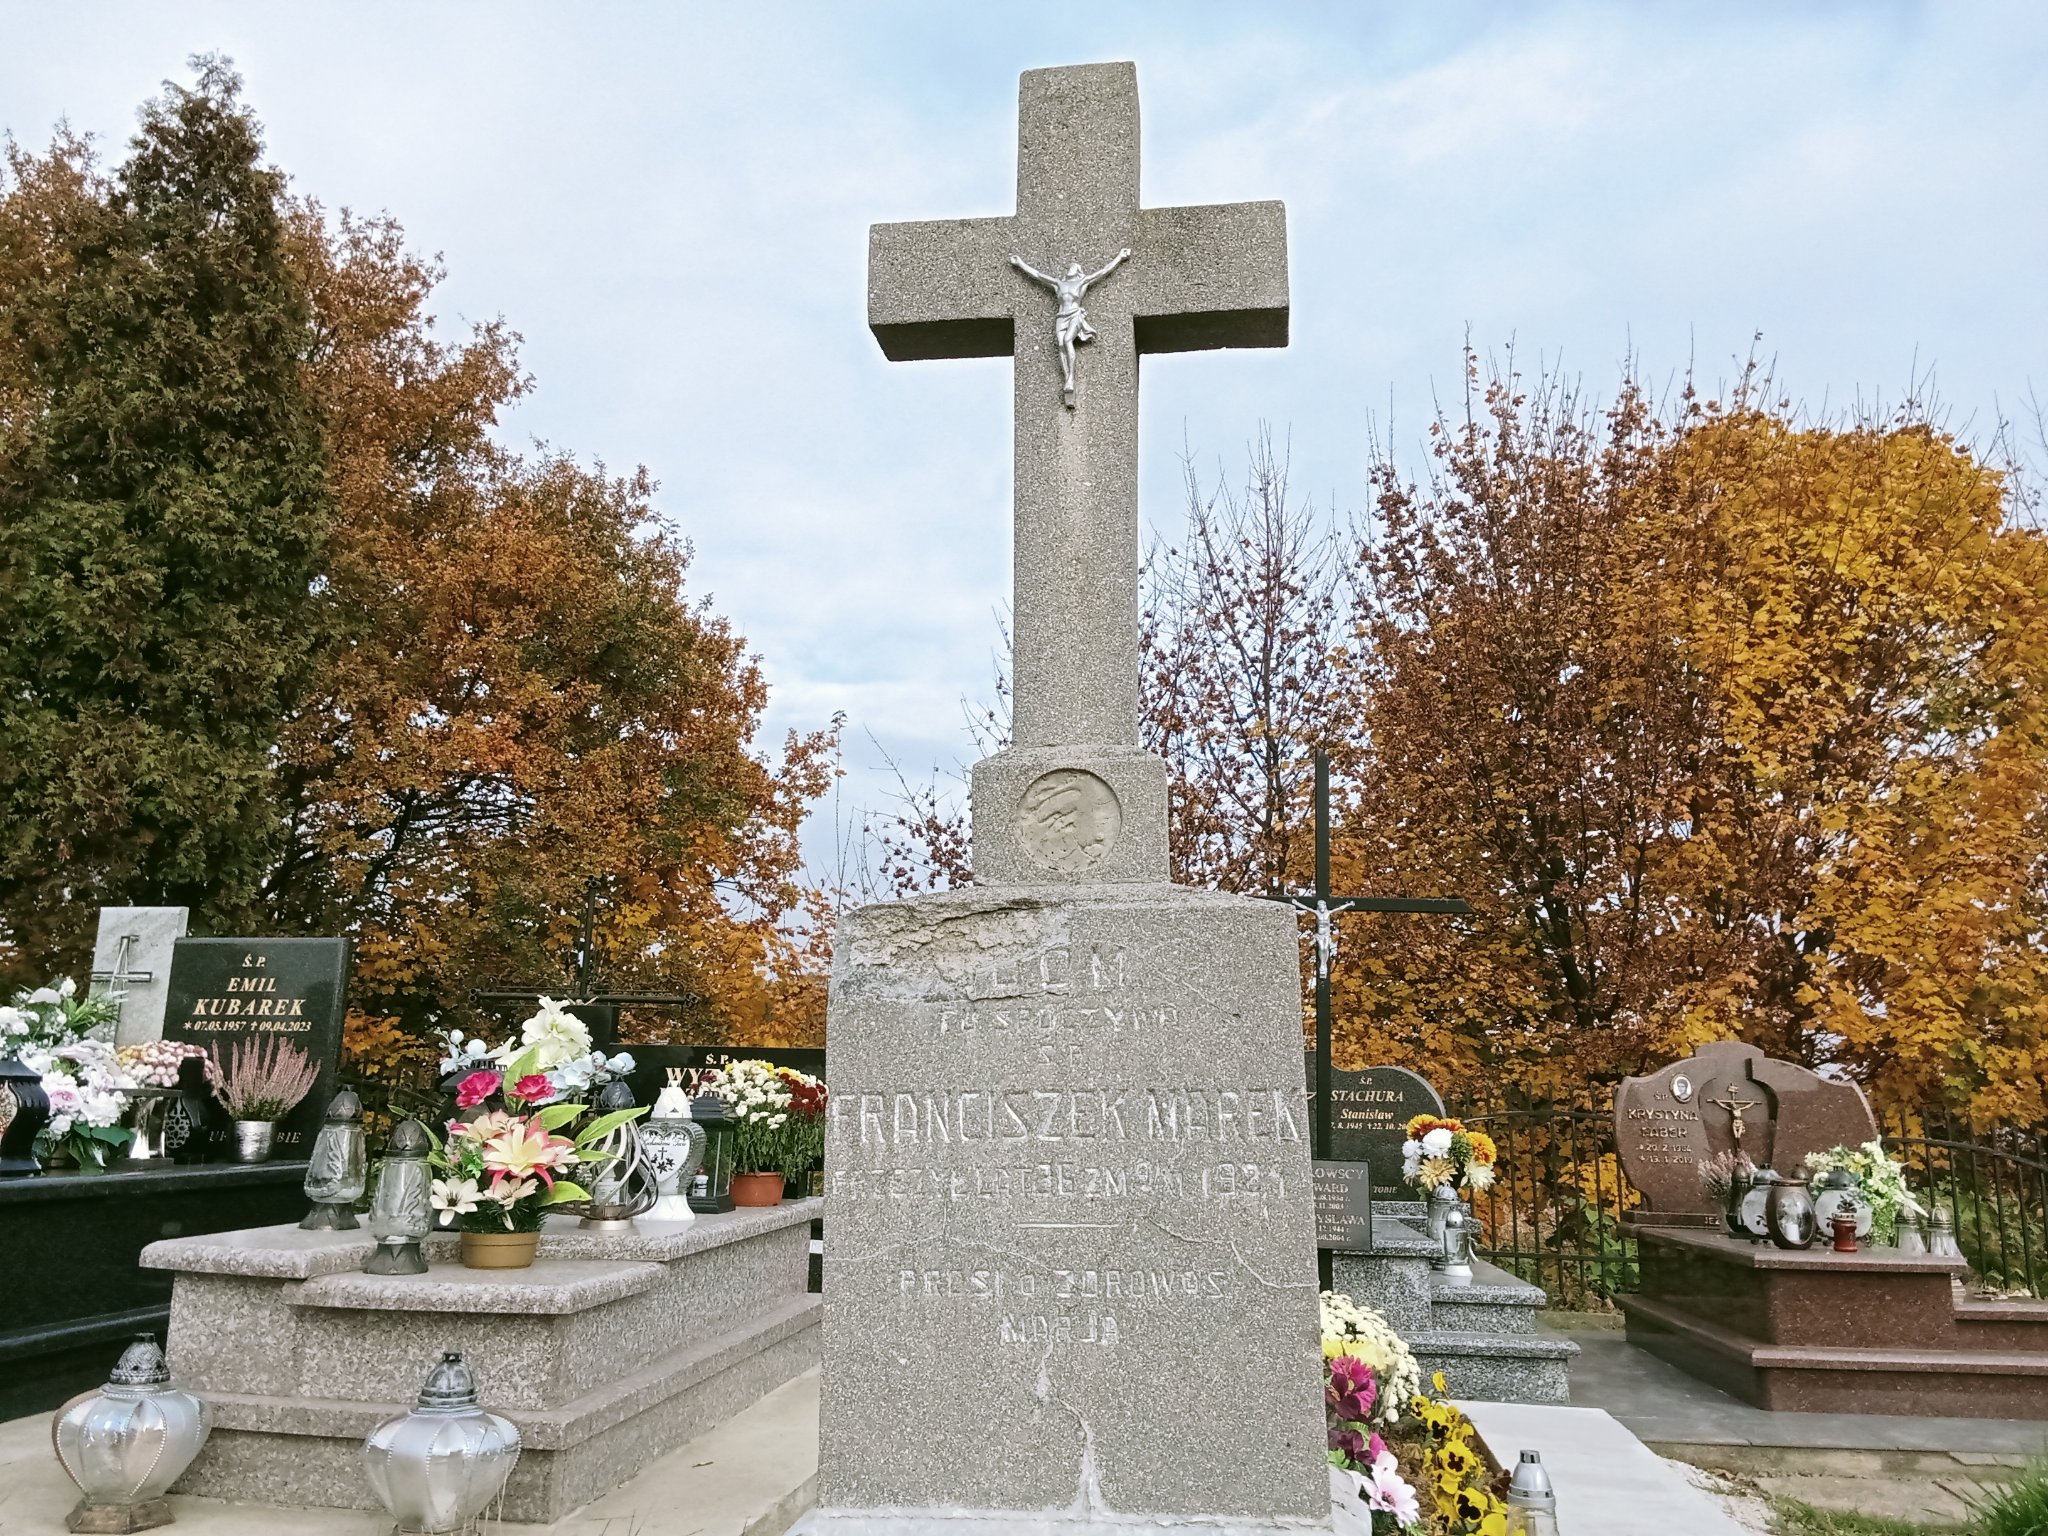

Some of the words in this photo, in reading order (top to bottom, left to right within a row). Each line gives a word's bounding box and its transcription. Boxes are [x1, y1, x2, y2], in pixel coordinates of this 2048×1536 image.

[226, 977, 277, 992] EMIL
[192, 998, 307, 1016] KUBAREK
[194, 1021, 247, 1031] 07.05.1957
[259, 1021, 312, 1032] 09.04.2023
[1330, 1090, 1404, 1102] STACHURA
[829, 1089, 1129, 1145] FRANCISZEK
[1146, 1089, 1303, 1145] MAREK
[1628, 1108, 1699, 1120] KRYSTYNA
[1373, 1186, 1398, 1194] TOBIE
